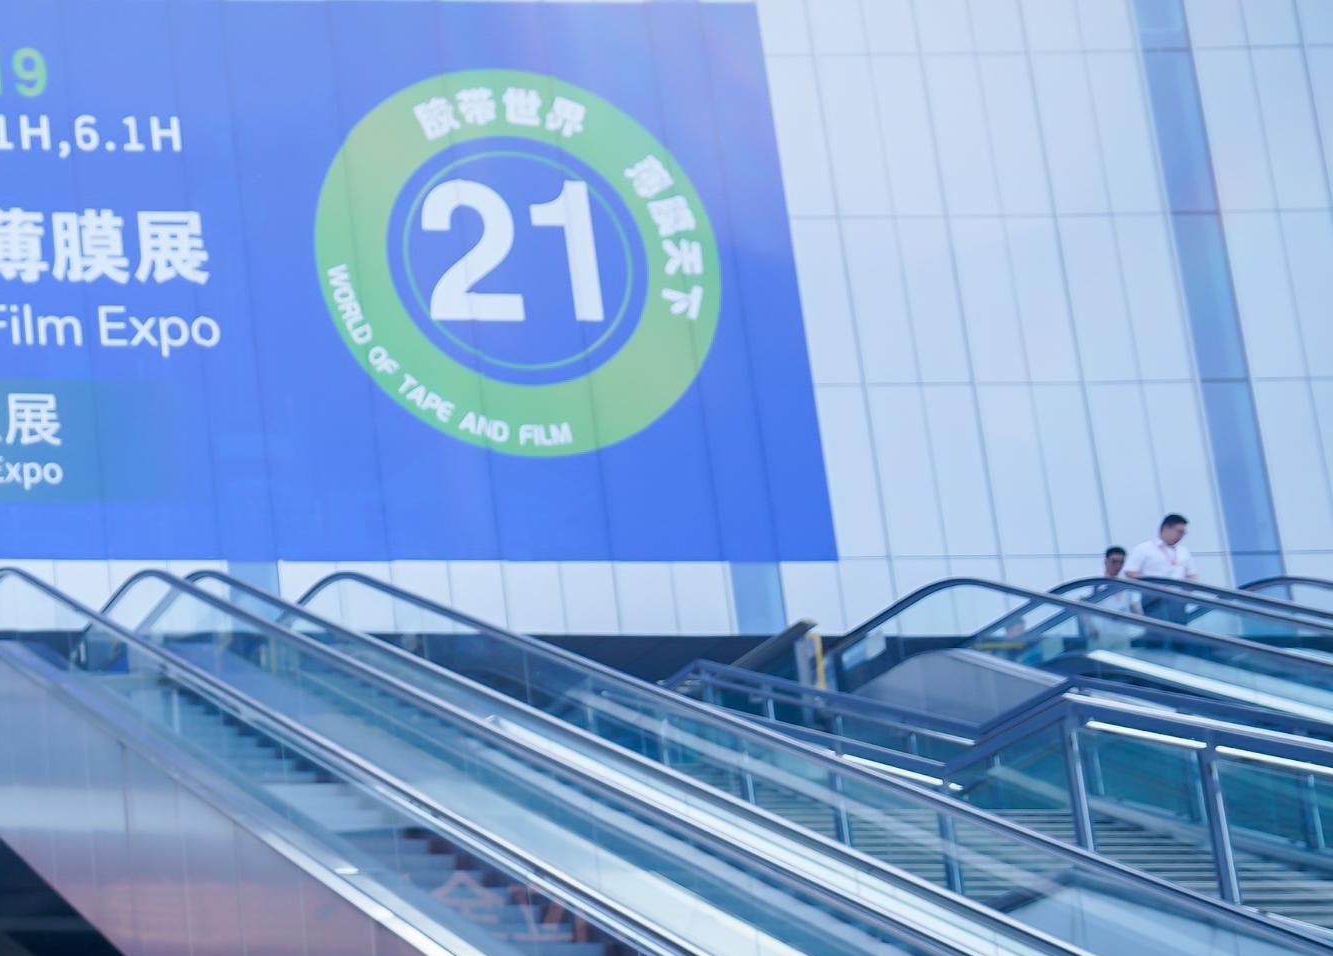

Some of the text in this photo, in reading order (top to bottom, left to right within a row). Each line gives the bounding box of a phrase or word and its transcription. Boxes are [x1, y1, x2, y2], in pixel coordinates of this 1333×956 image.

[413, 87, 586, 141] 胶带世界
[421, 178, 605, 322] 21
[98, 305, 221, 358] Expo
[326, 264, 573, 447] WORLD OF TAPE AND FILM
